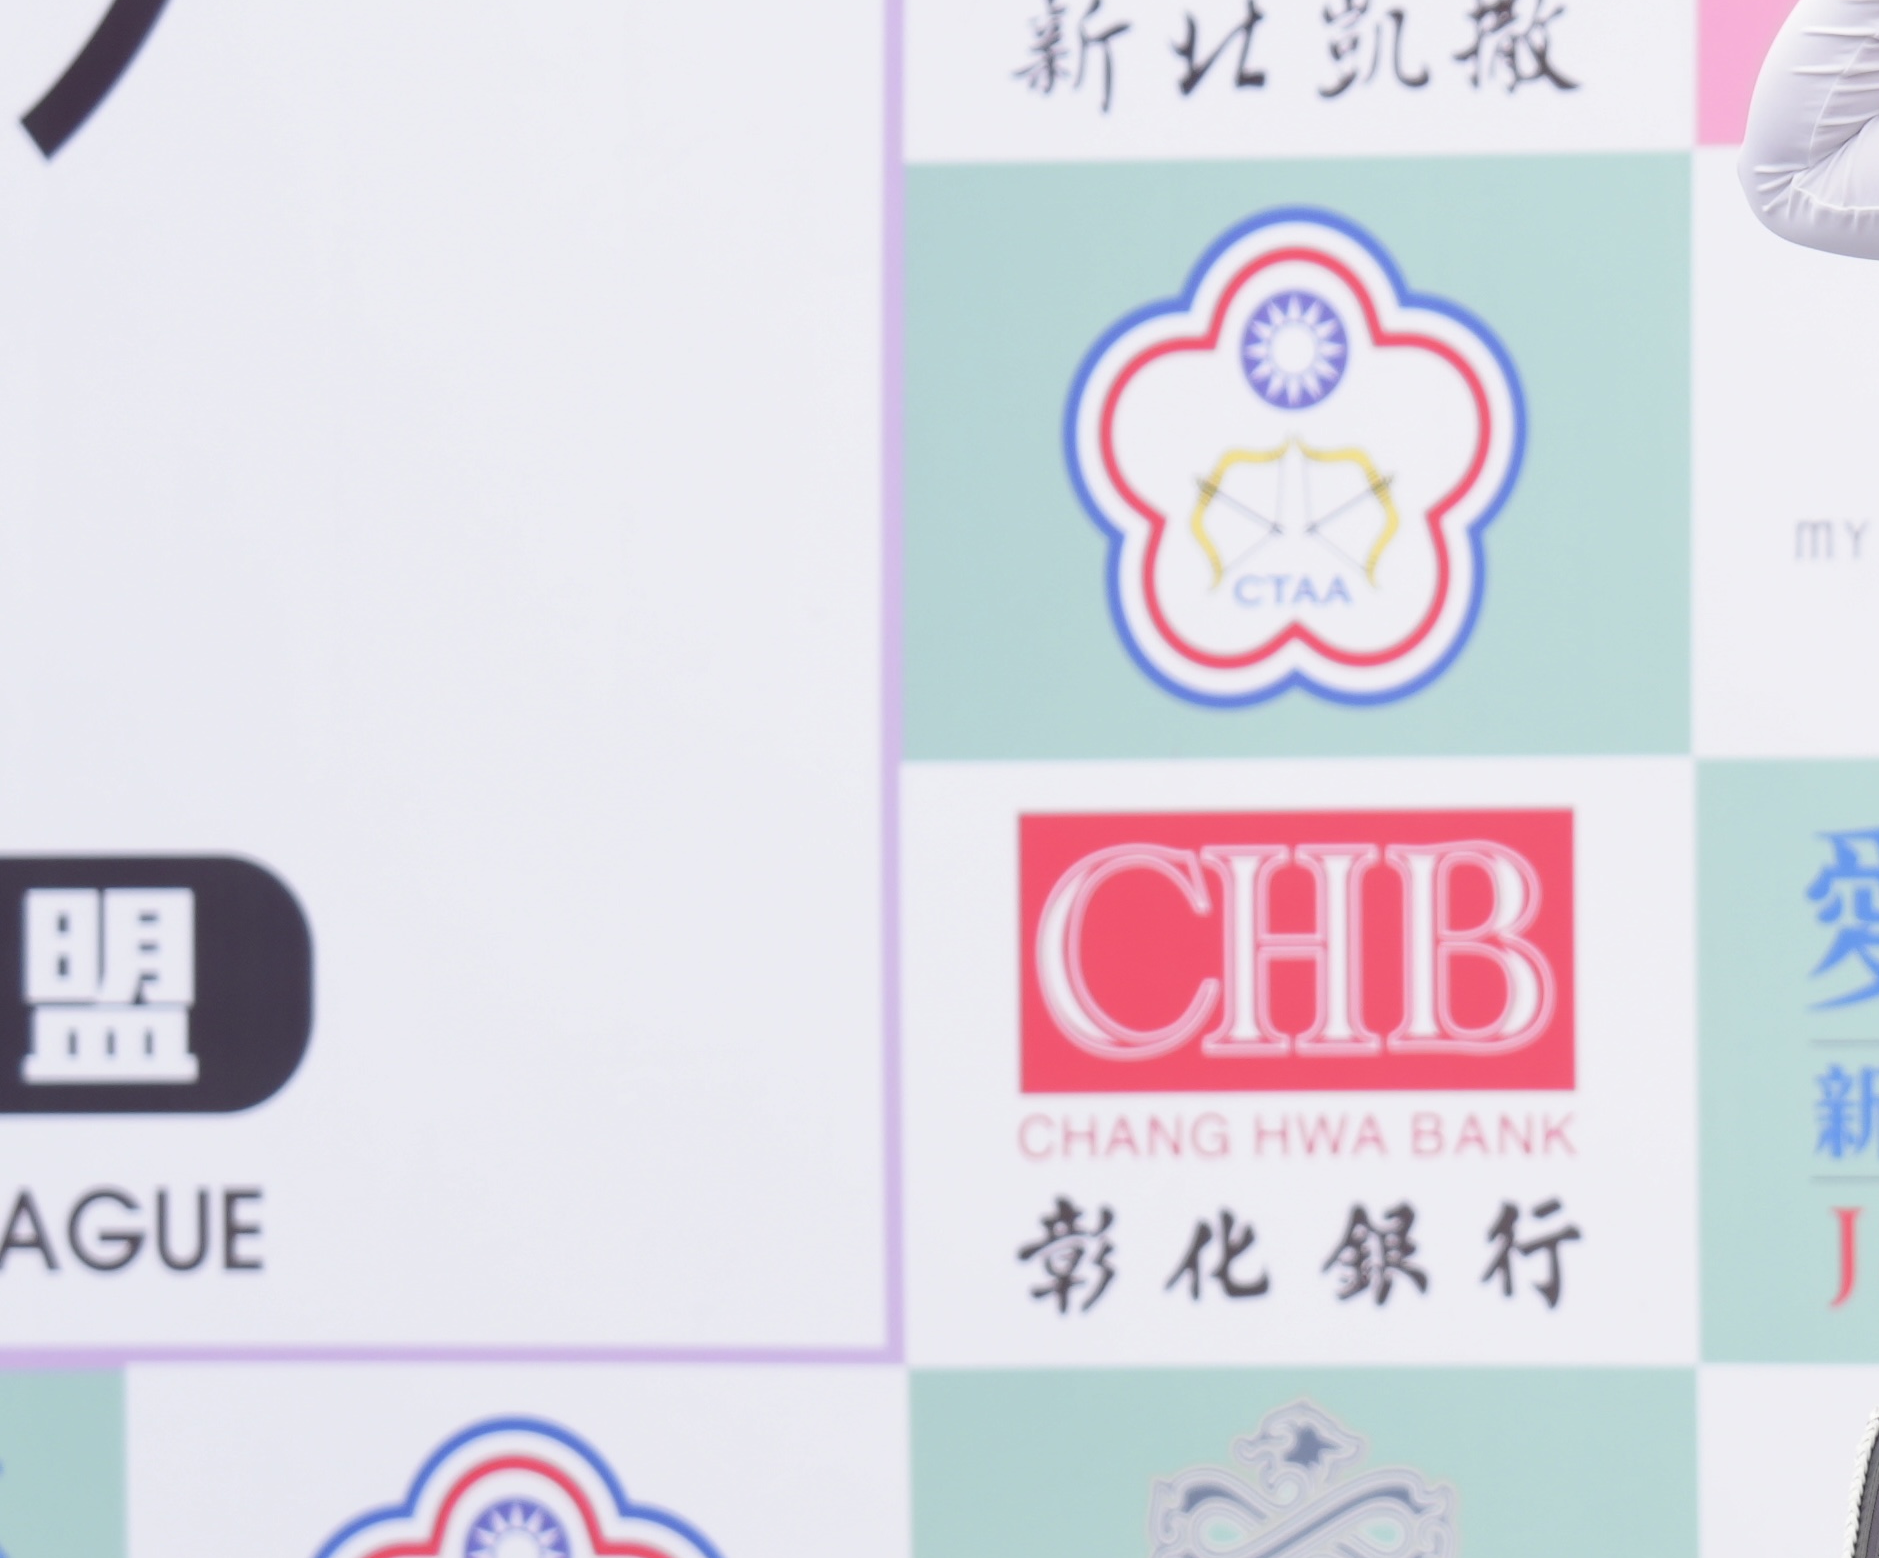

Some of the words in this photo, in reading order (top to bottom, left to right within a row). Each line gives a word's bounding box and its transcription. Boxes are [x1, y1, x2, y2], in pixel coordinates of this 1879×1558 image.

[1795, 518, 1872, 559] MY
[1232, 572, 1353, 610] CTAA
[20, 886, 200, 1085] 盟
[1036, 839, 1556, 1061] CHB
[1018, 1113, 1230, 1161] CHANG
[1254, 1113, 1389, 1159] HWA
[1410, 1111, 1578, 1158] BANK
[1017, 1195, 1584, 1314] 彰化銀行
